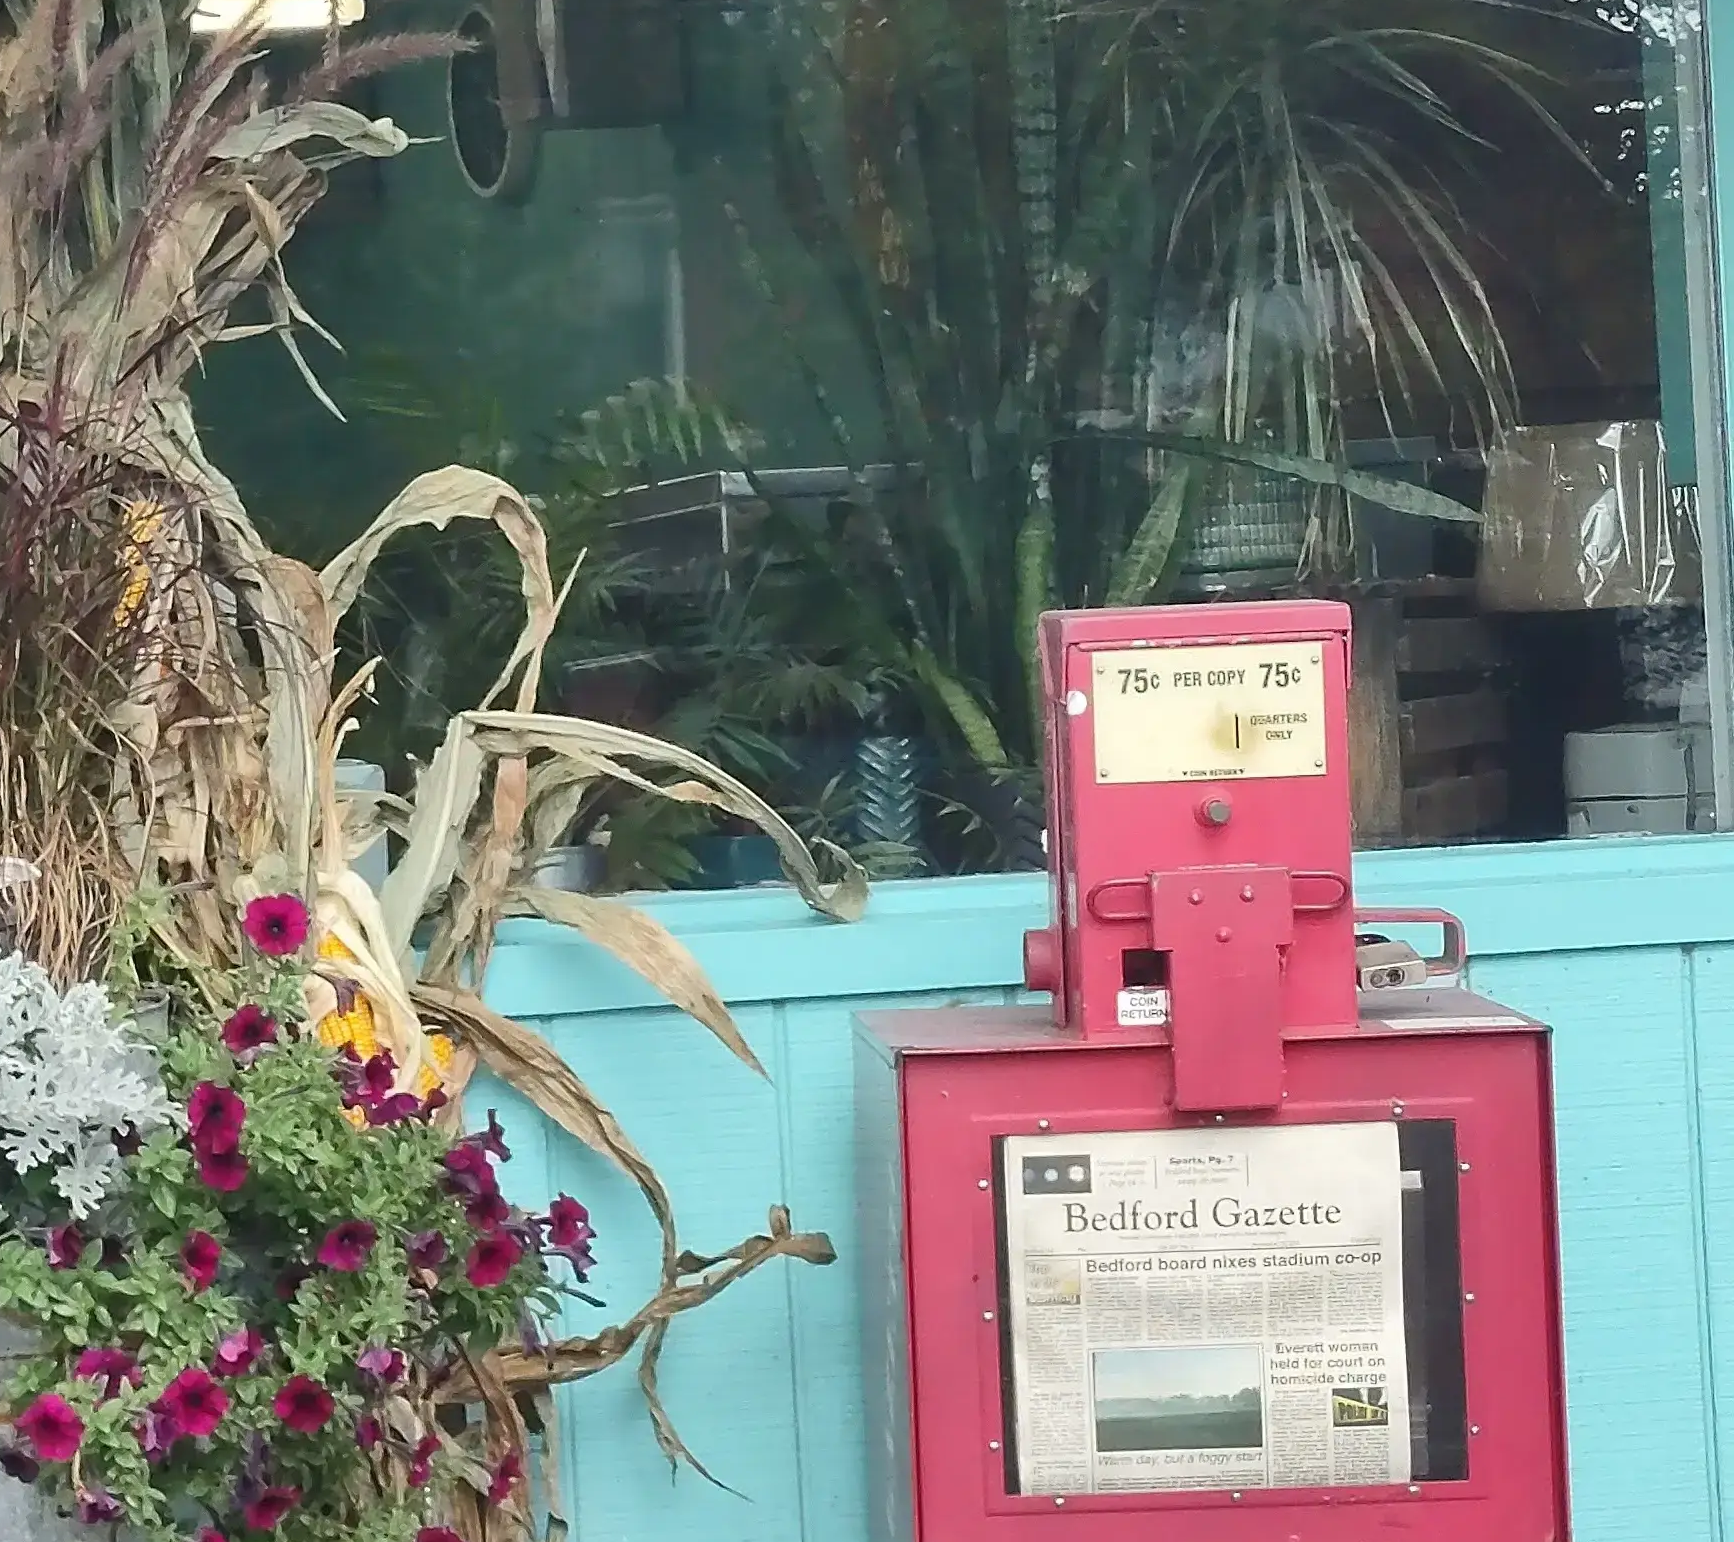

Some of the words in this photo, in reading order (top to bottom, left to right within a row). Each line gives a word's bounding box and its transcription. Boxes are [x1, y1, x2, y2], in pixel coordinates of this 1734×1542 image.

[1172, 671, 1203, 688] PER
[1207, 669, 1246, 686] COPY
[1249, 713, 1308, 727] QUARTERS
[1265, 730, 1293, 740] ONLY
[1129, 996, 1159, 1007] COIN
[1121, 1008, 1167, 1019] RETURN
[1062, 1197, 1199, 1233] Bedford
[1212, 1197, 1342, 1228] Gazette
[1086, 1258, 1152, 1273] Bedford
[1158, 1256, 1207, 1270] board
[1213, 1255, 1257, 1269] nixes
[1263, 1253, 1330, 1267] stadium
[1335, 1251, 1382, 1265] co-op
[1328, 1342, 1378, 1352] woman
[1270, 1358, 1299, 1370] held
[1304, 1357, 1323, 1369] for
[1327, 1357, 1363, 1368] court
[1367, 1357, 1386, 1367] on
[1270, 1373, 1334, 1385] homicide
[1338, 1372, 1387, 1385] charge
[1187, 1455, 1195, 1464] a
[1197, 1452, 1233, 1465] foggy
[1235, 1451, 1264, 1462] start
